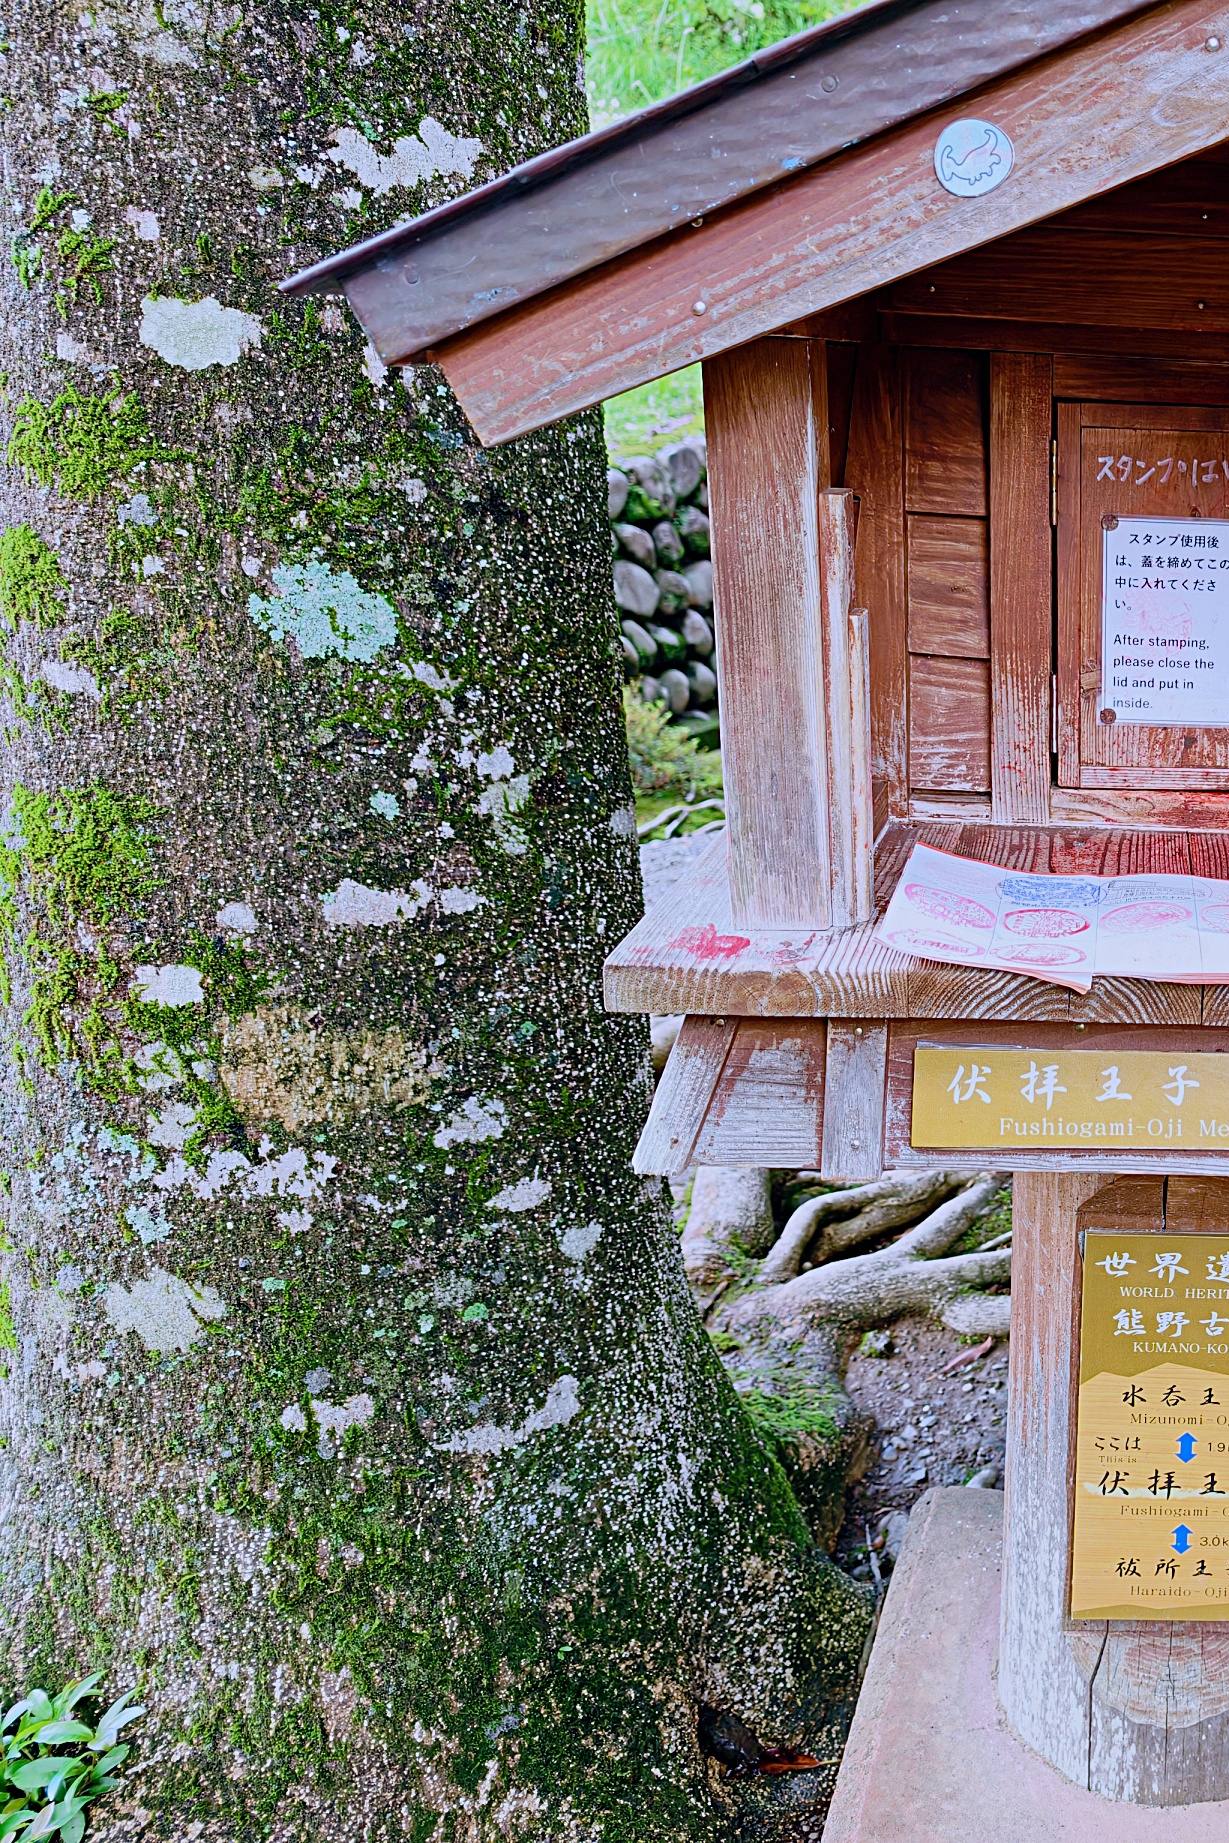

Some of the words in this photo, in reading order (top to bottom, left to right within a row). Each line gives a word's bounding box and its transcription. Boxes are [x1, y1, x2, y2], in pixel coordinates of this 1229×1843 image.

[1129, 533, 1220, 549] スタンプ使用後
[1115, 575, 1217, 592] 中に入れてくださ
[1115, 599, 1132, 611] い。
[1113, 634, 1144, 646] After
[1148, 636, 1210, 651] stamping,
[1113, 655, 1154, 668] please
[1158, 657, 1190, 669] close
[1195, 658, 1215, 670] the
[1113, 676, 1128, 687] lid
[1132, 678, 1155, 689] and
[1159, 679, 1179, 691] put
[1183, 679, 1194, 689] in
[1113, 697, 1153, 709] inside.
[998, 1116, 1184, 1139] Fushiogami-Oji
[1119, 1286, 1175, 1299] WORLD
[1094, 1436, 1141, 1451] ここは
[1098, 1455, 1123, 1463] This
[1127, 1455, 1137, 1463] is
[1130, 1586, 1227, 1598] Haraido-Oji
